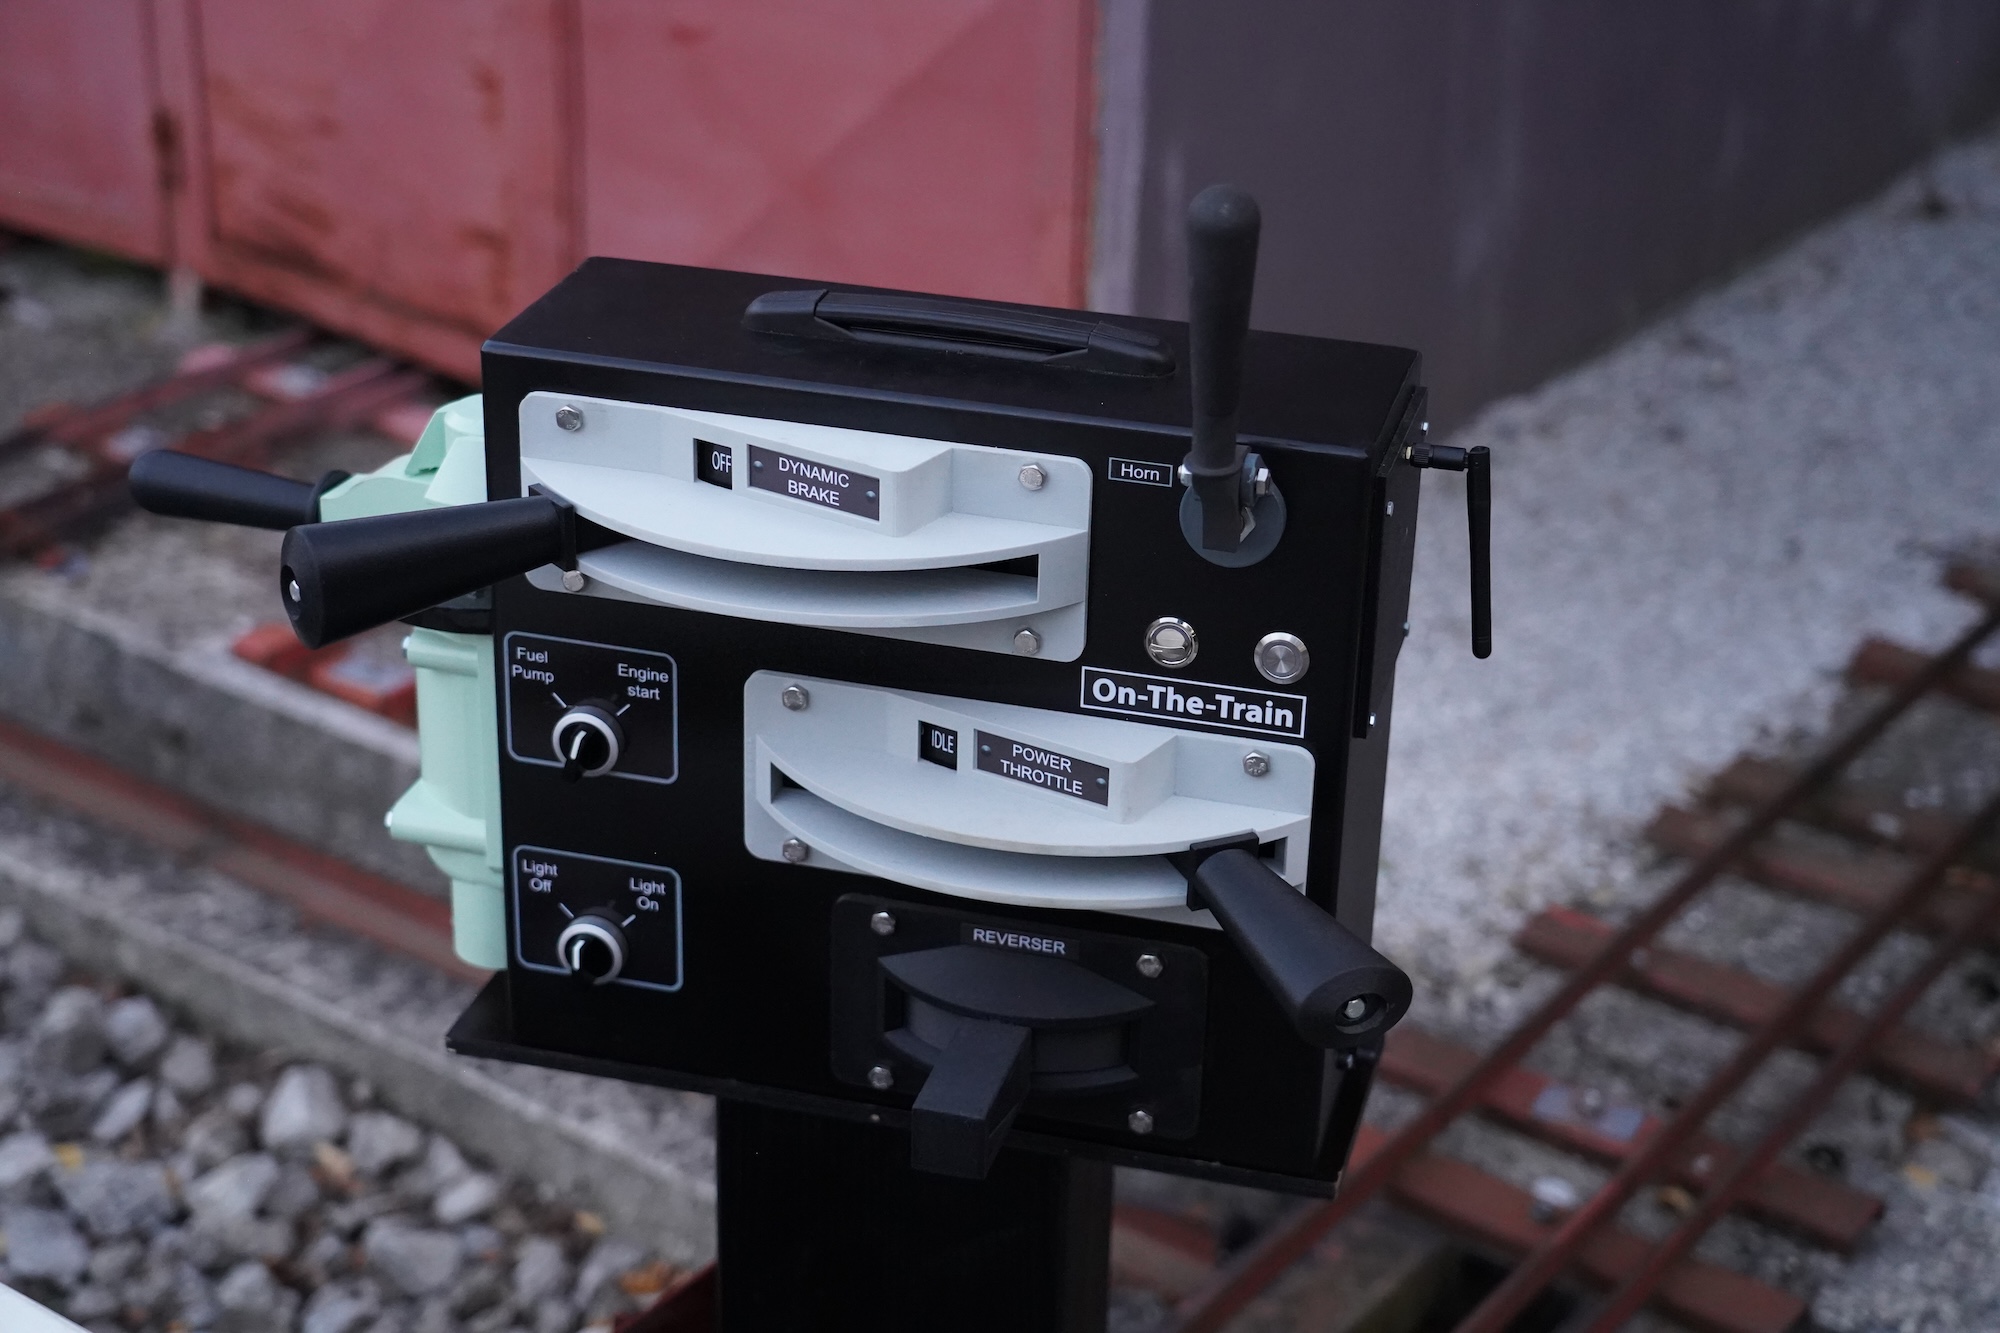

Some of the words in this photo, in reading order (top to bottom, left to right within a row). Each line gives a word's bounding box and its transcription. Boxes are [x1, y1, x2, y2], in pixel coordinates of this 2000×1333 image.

[711, 451, 732, 473] OFF
[778, 457, 850, 488] DYNAMIC
[1121, 463, 1160, 481] Horn
[788, 479, 840, 506] BRAKE
[516, 646, 548, 663] Fuel
[512, 664, 555, 685] Pump
[617, 662, 669, 683] Engine
[627, 685, 660, 700] start
[1092, 677, 1294, 728] On-The-Train
[931, 729, 954, 754] IDLE
[1012, 744, 1072, 773] POWER
[1000, 759, 1083, 795] THROTTLE
[522, 859, 558, 877] Light
[529, 878, 552, 893] Off
[630, 877, 666, 895] Light
[636, 896, 659, 911] On
[973, 928, 1066, 955] REVERSER
